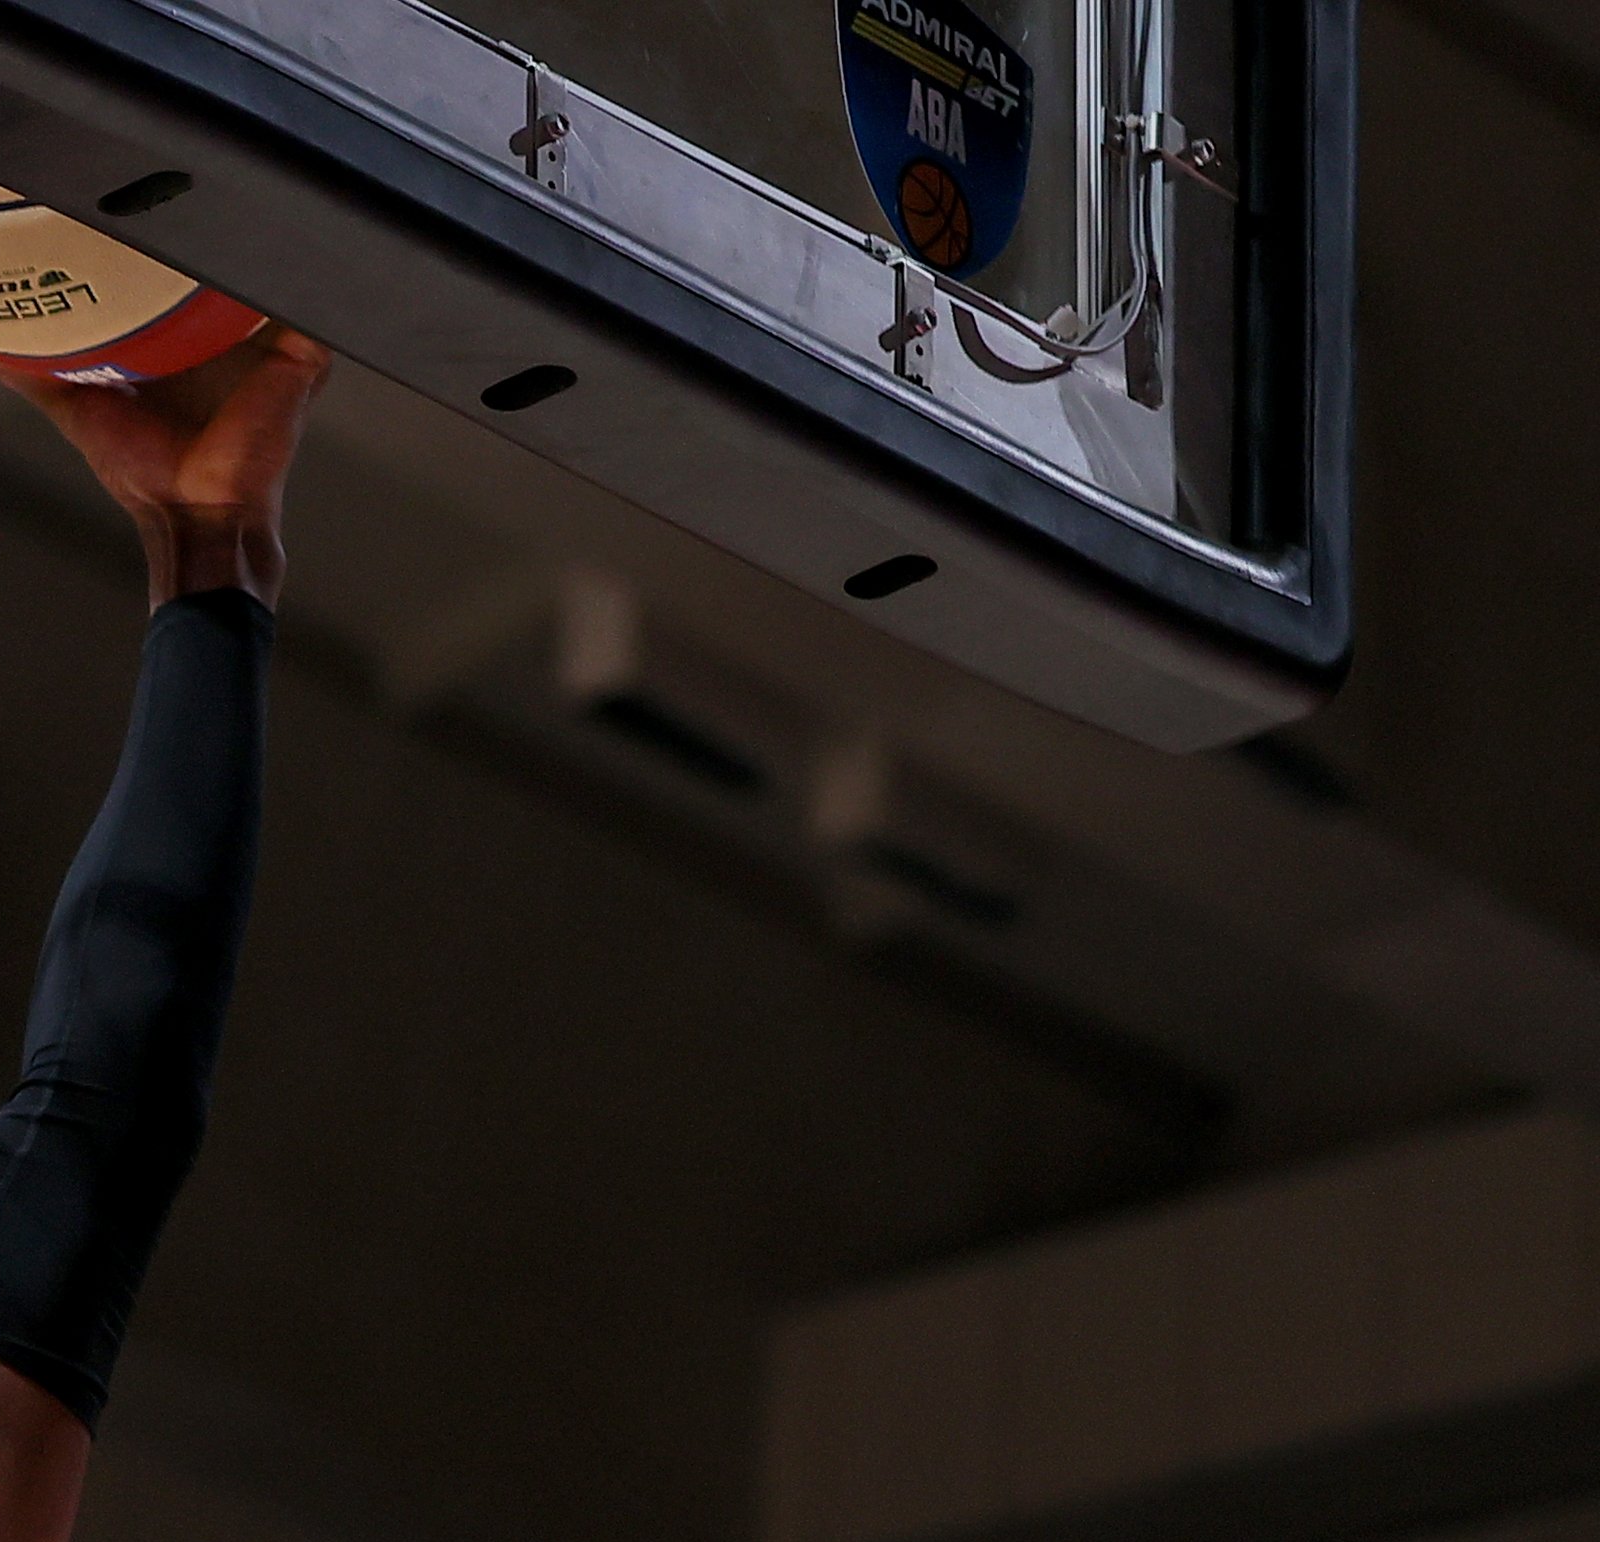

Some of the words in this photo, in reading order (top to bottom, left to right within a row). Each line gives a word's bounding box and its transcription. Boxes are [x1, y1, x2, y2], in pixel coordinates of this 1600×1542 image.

[862, 0, 1020, 96] ADMIRAL
[906, 78, 967, 167] ABA
[963, 76, 1019, 118] BET
